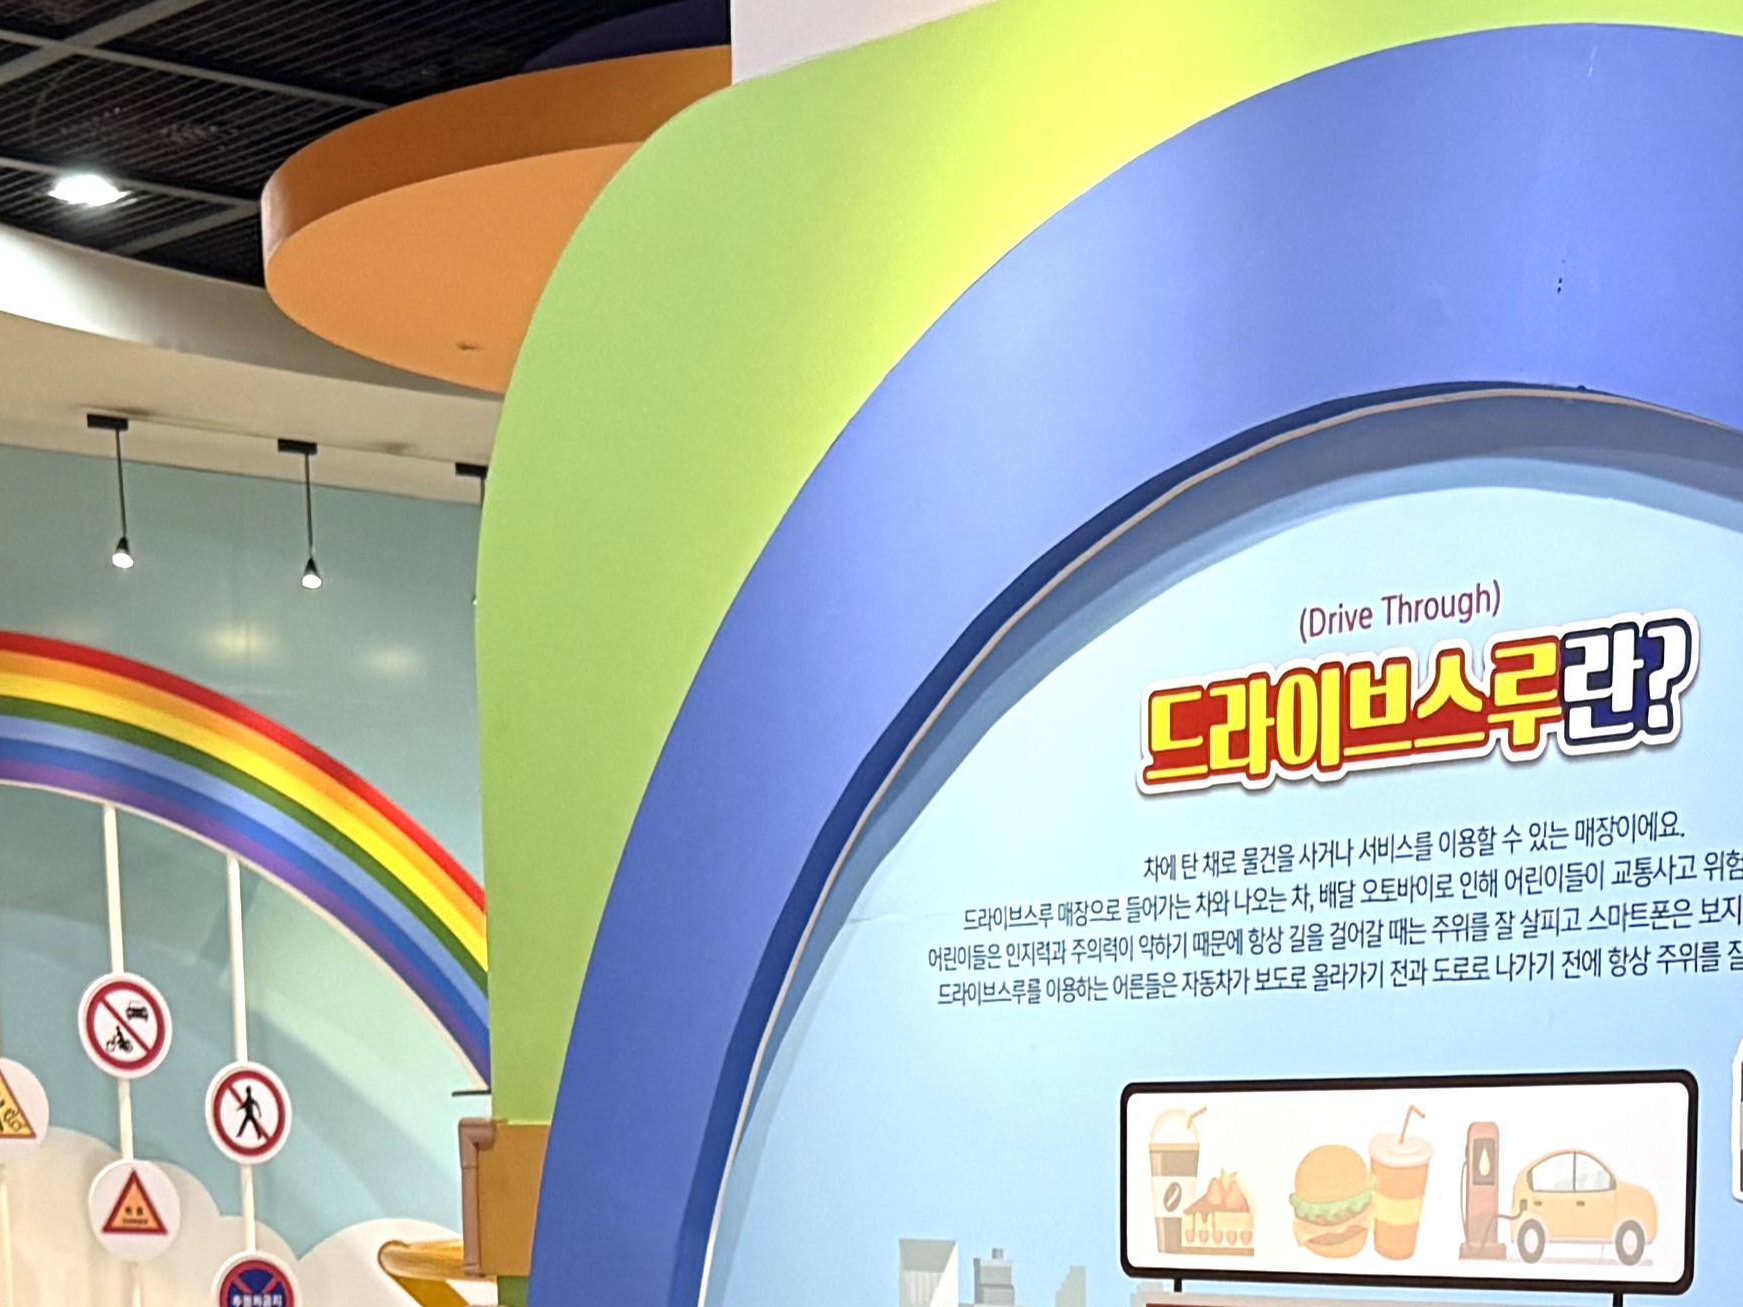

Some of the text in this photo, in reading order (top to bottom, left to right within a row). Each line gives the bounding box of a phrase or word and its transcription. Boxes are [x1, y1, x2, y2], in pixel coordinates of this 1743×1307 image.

[1299, 580, 1501, 644] (Drive Through)
[1144, 618, 1691, 784] 드라이브스루란?
[1144, 810, 1686, 882] 차에 탄 채로 물건을 사거나 서비스를 이용할 수 있는 매장이에요.
[964, 902, 1053, 932] 드라이브스루
[1058, 898, 1121, 927] 매장으로
[1126, 893, 1191, 923] 들어가는
[1196, 890, 1229, 917] 차와
[1234, 886, 1287, 913] 나오는
[1292, 883, 1314, 913] 차,
[1320, 880, 1355, 911] 배달
[1360, 873, 1454, 905] 오토바이로
[1460, 868, 1498, 900] 인해
[1505, 860, 1604, 896] 어린이들이
[1611, 854, 1698, 889] 교통사고
[928, 943, 1001, 972] 어린이들은
[1006, 939, 1066, 968] 인지력과
[1071, 935, 1133, 964] 주의력이
[1139, 931, 1187, 961] 약하기
[1193, 927, 1243, 957] 때문에
[1248, 926, 1283, 955] 항상
[1289, 924, 1325, 953] 길을
[1330, 919, 1383, 950] 걸어갈
[1389, 917, 1427, 947] 때는
[1432, 912, 1490, 944] 주위를
[1495, 909, 1515, 940] 잘
[1520, 906, 1582, 938] 살피고
[1587, 899, 1693, 932] 스마트폰은
[1699, 895, 1742, 926] 보지
[937, 977, 1041, 1007] 드라이브스루를
[1046, 974, 1108, 1003] 이용하는
[1113, 970, 1178, 999] 어른들은
[1182, 967, 1250, 997] 자동차가
[1254, 965, 1307, 991] 보도로
[1313, 960, 1384, 992] 올라가기
[1390, 957, 1427, 987] 전과
[1432, 955, 1490, 982] 도로로
[1496, 949, 1554, 983] 나가기
[1561, 947, 1602, 979] 전에
[1608, 944, 1650, 977] 항상
[1657, 940, 1720, 974] 주위를
